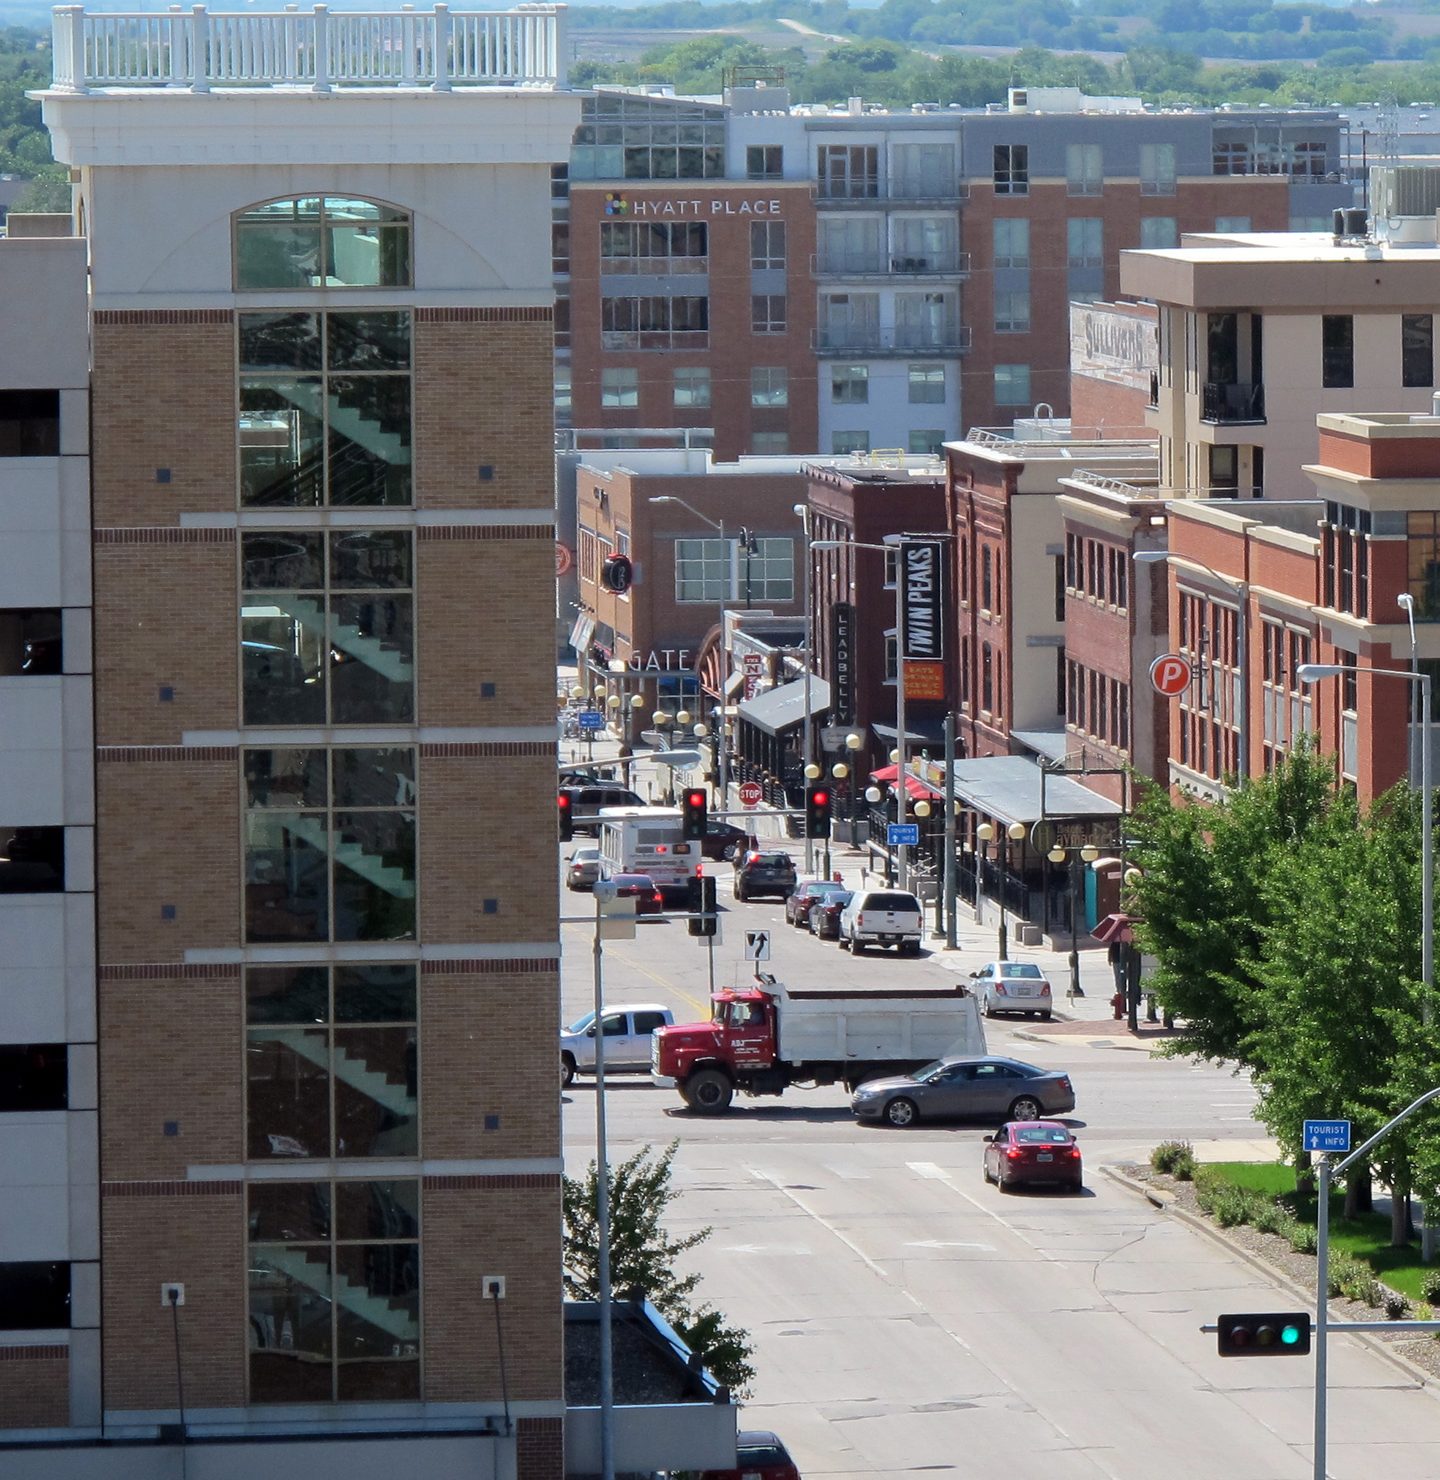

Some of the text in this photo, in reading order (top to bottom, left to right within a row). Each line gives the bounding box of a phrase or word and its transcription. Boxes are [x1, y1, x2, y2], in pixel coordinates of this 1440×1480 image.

[633, 199, 781, 215] HYATT PLACE
[907, 547, 933, 654] TWIN PEAKS
[627, 649, 690, 671] GATE
[746, 665, 759, 674] N
[837, 615, 848, 720] LEADBELLY
[1161, 662, 1182, 690] P
[739, 790, 760, 798] STOP
[1309, 1126, 1345, 1134] TOURIST
